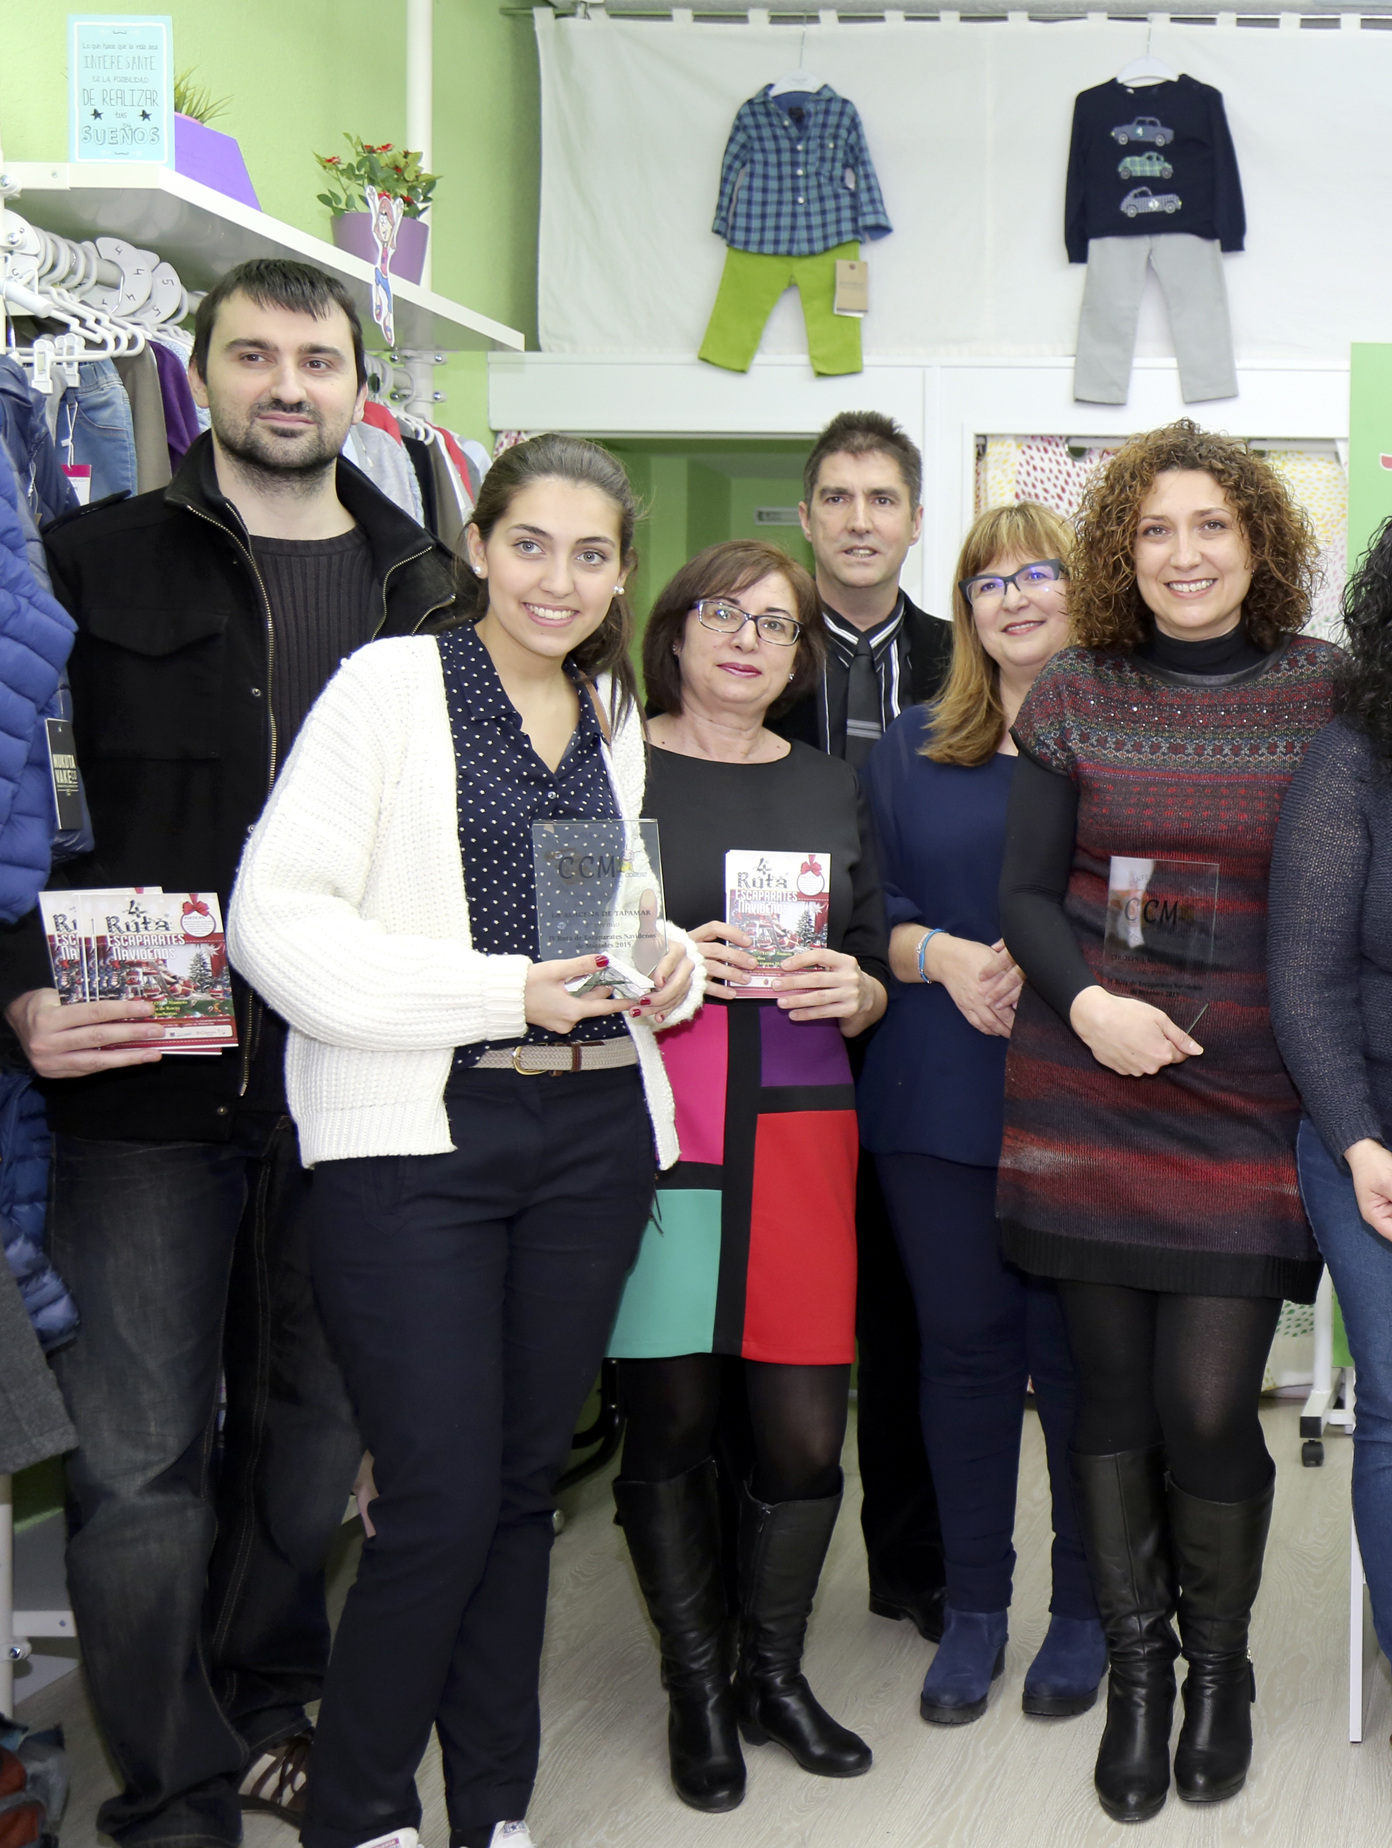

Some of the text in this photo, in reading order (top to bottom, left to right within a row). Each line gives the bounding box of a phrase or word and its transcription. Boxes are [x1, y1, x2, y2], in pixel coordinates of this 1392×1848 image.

[84, 54, 157, 71] INTERESANTE
[82, 88, 160, 107] DE REALIZAR
[82, 123, 160, 145] SUEÑOS
[558, 855, 616, 879] CCM
[737, 872, 788, 889] Ruta
[736, 889, 798, 902] ESCAPARATES
[1124, 897, 1179, 925] CCM
[106, 915, 171, 934] Ruta
[106, 933, 186, 947] ESCAPARATES
